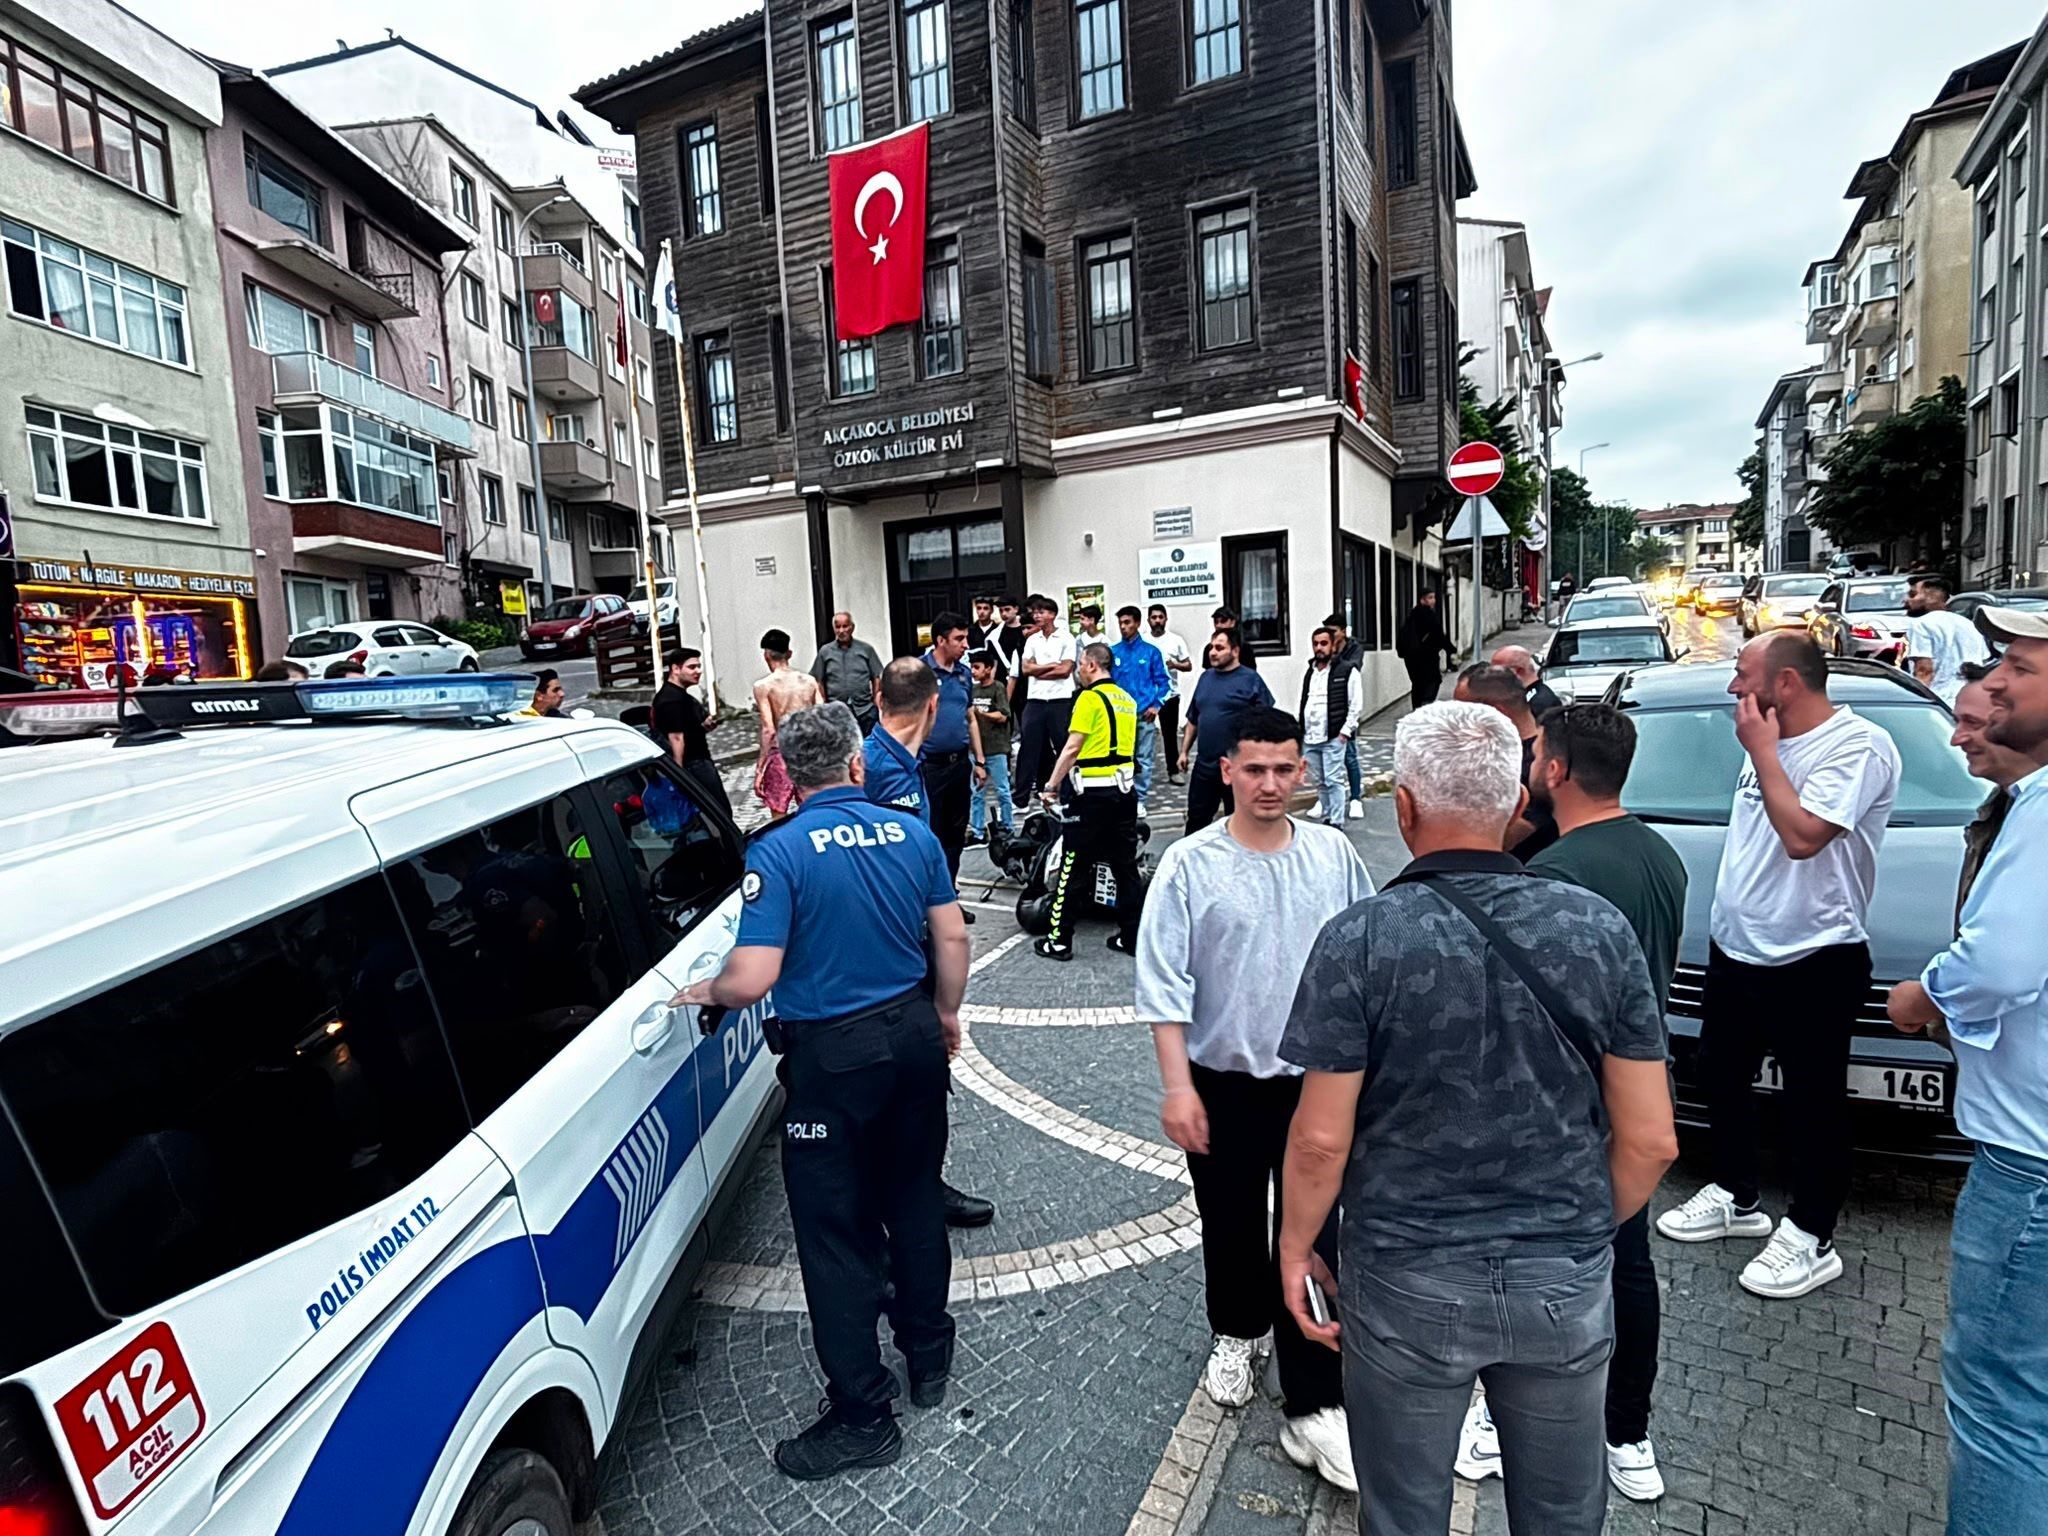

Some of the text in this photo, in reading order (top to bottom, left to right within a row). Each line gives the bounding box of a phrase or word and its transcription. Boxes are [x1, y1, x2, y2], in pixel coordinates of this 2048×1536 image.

[822, 402, 974, 445] AKÇAKOCA BELEDİYESİ
[834, 429, 964, 468] ÖZKÖK KÜLTÜR EVİ
[30, 561, 71, 581] TÜTÜN
[80, 567, 126, 585] NRGİLE
[134, 572, 182, 589] MAKARON
[723, 989, 776, 1089] POL
[1884, 1070, 1941, 1102] 146
[306, 1197, 440, 1331] POLİS İMDAT 112
[82, 1348, 177, 1452] 112
